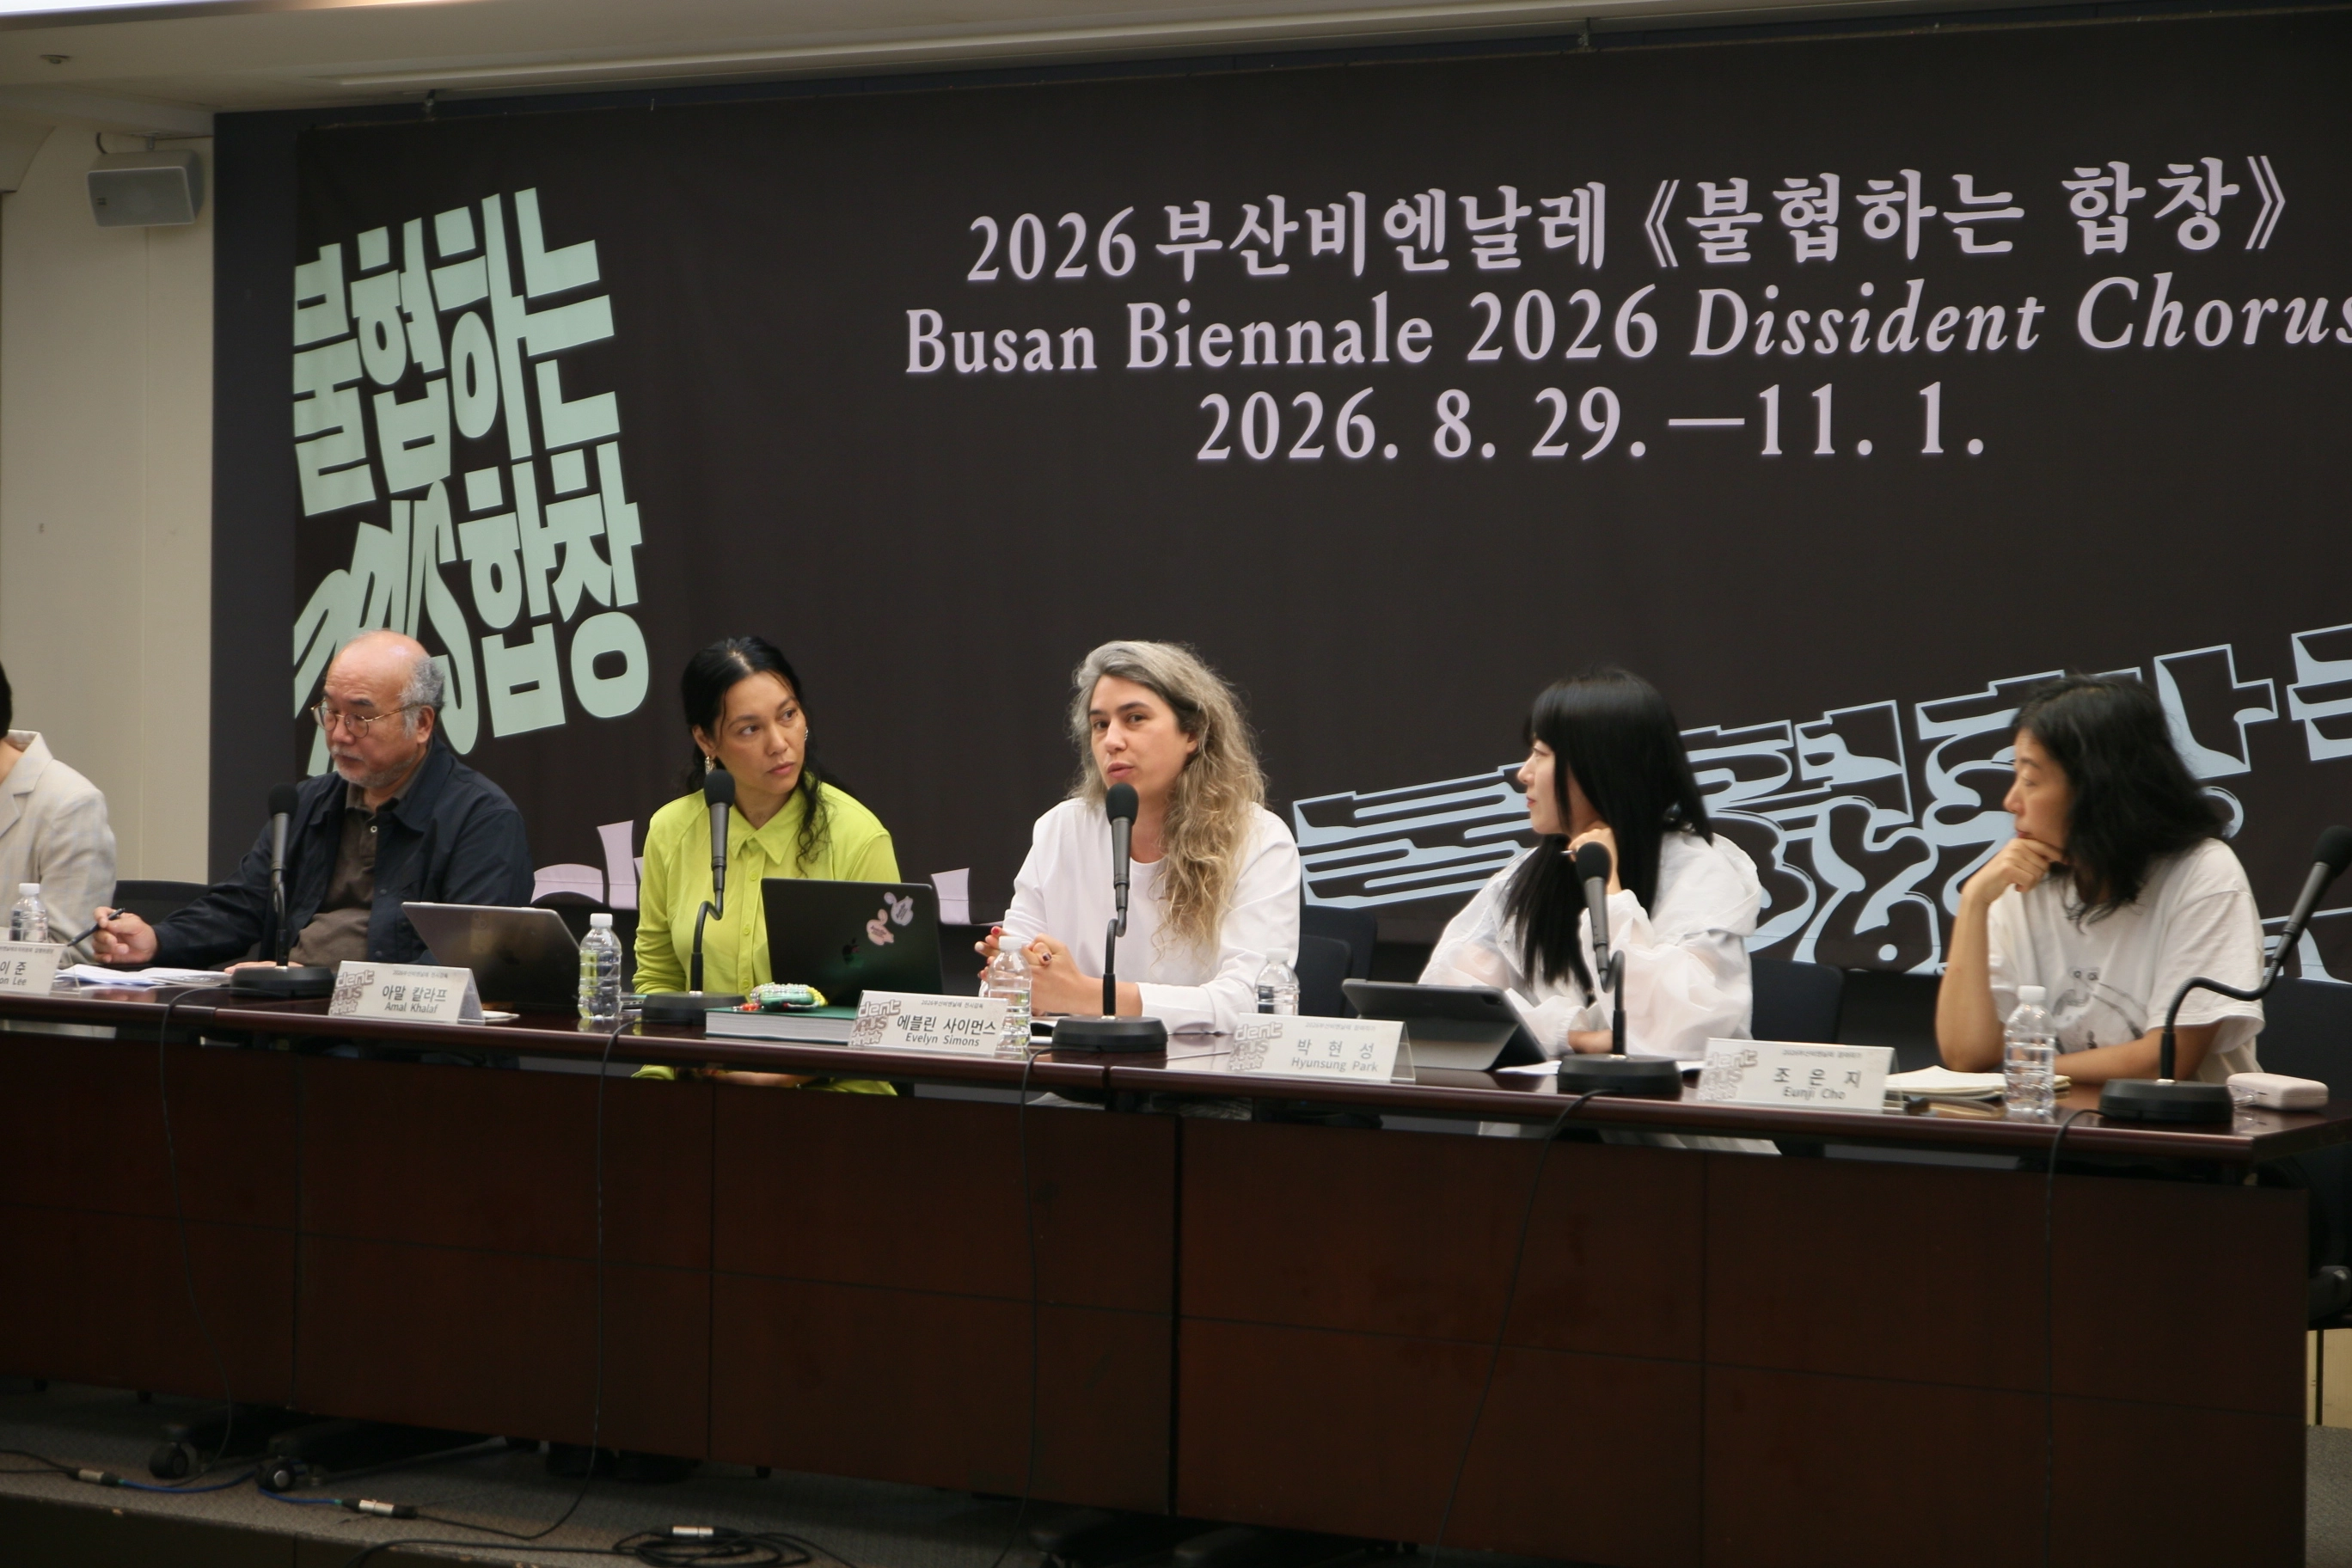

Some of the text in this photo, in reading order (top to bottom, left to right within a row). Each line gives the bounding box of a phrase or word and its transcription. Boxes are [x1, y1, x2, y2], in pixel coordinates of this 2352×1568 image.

[967, 155, 2286, 283] 2026 부산비엔날레 《불협하는 합창》
[905, 308, 1098, 374] Busan
[1126, 291, 1434, 369] Biennale
[1467, 283, 1658, 362] 2026
[1689, 278, 2046, 357] Dissident
[1197, 386, 1399, 461] 2026.
[1433, 389, 1496, 459] 8.
[1919, 381, 1984, 456] 1.
[13, 977, 27, 986] Lee
[383, 984, 447, 1002] 아말 칼라프
[384, 1001, 438, 1014] Amal Khalaf
[897, 1014, 996, 1036] 에블린 사이먼스
[905, 1032, 980, 1047] Evelyn Simons
[1291, 1057, 1378, 1072] Hyunsung Park
[1783, 1086, 1847, 1101] Eunji Cho
